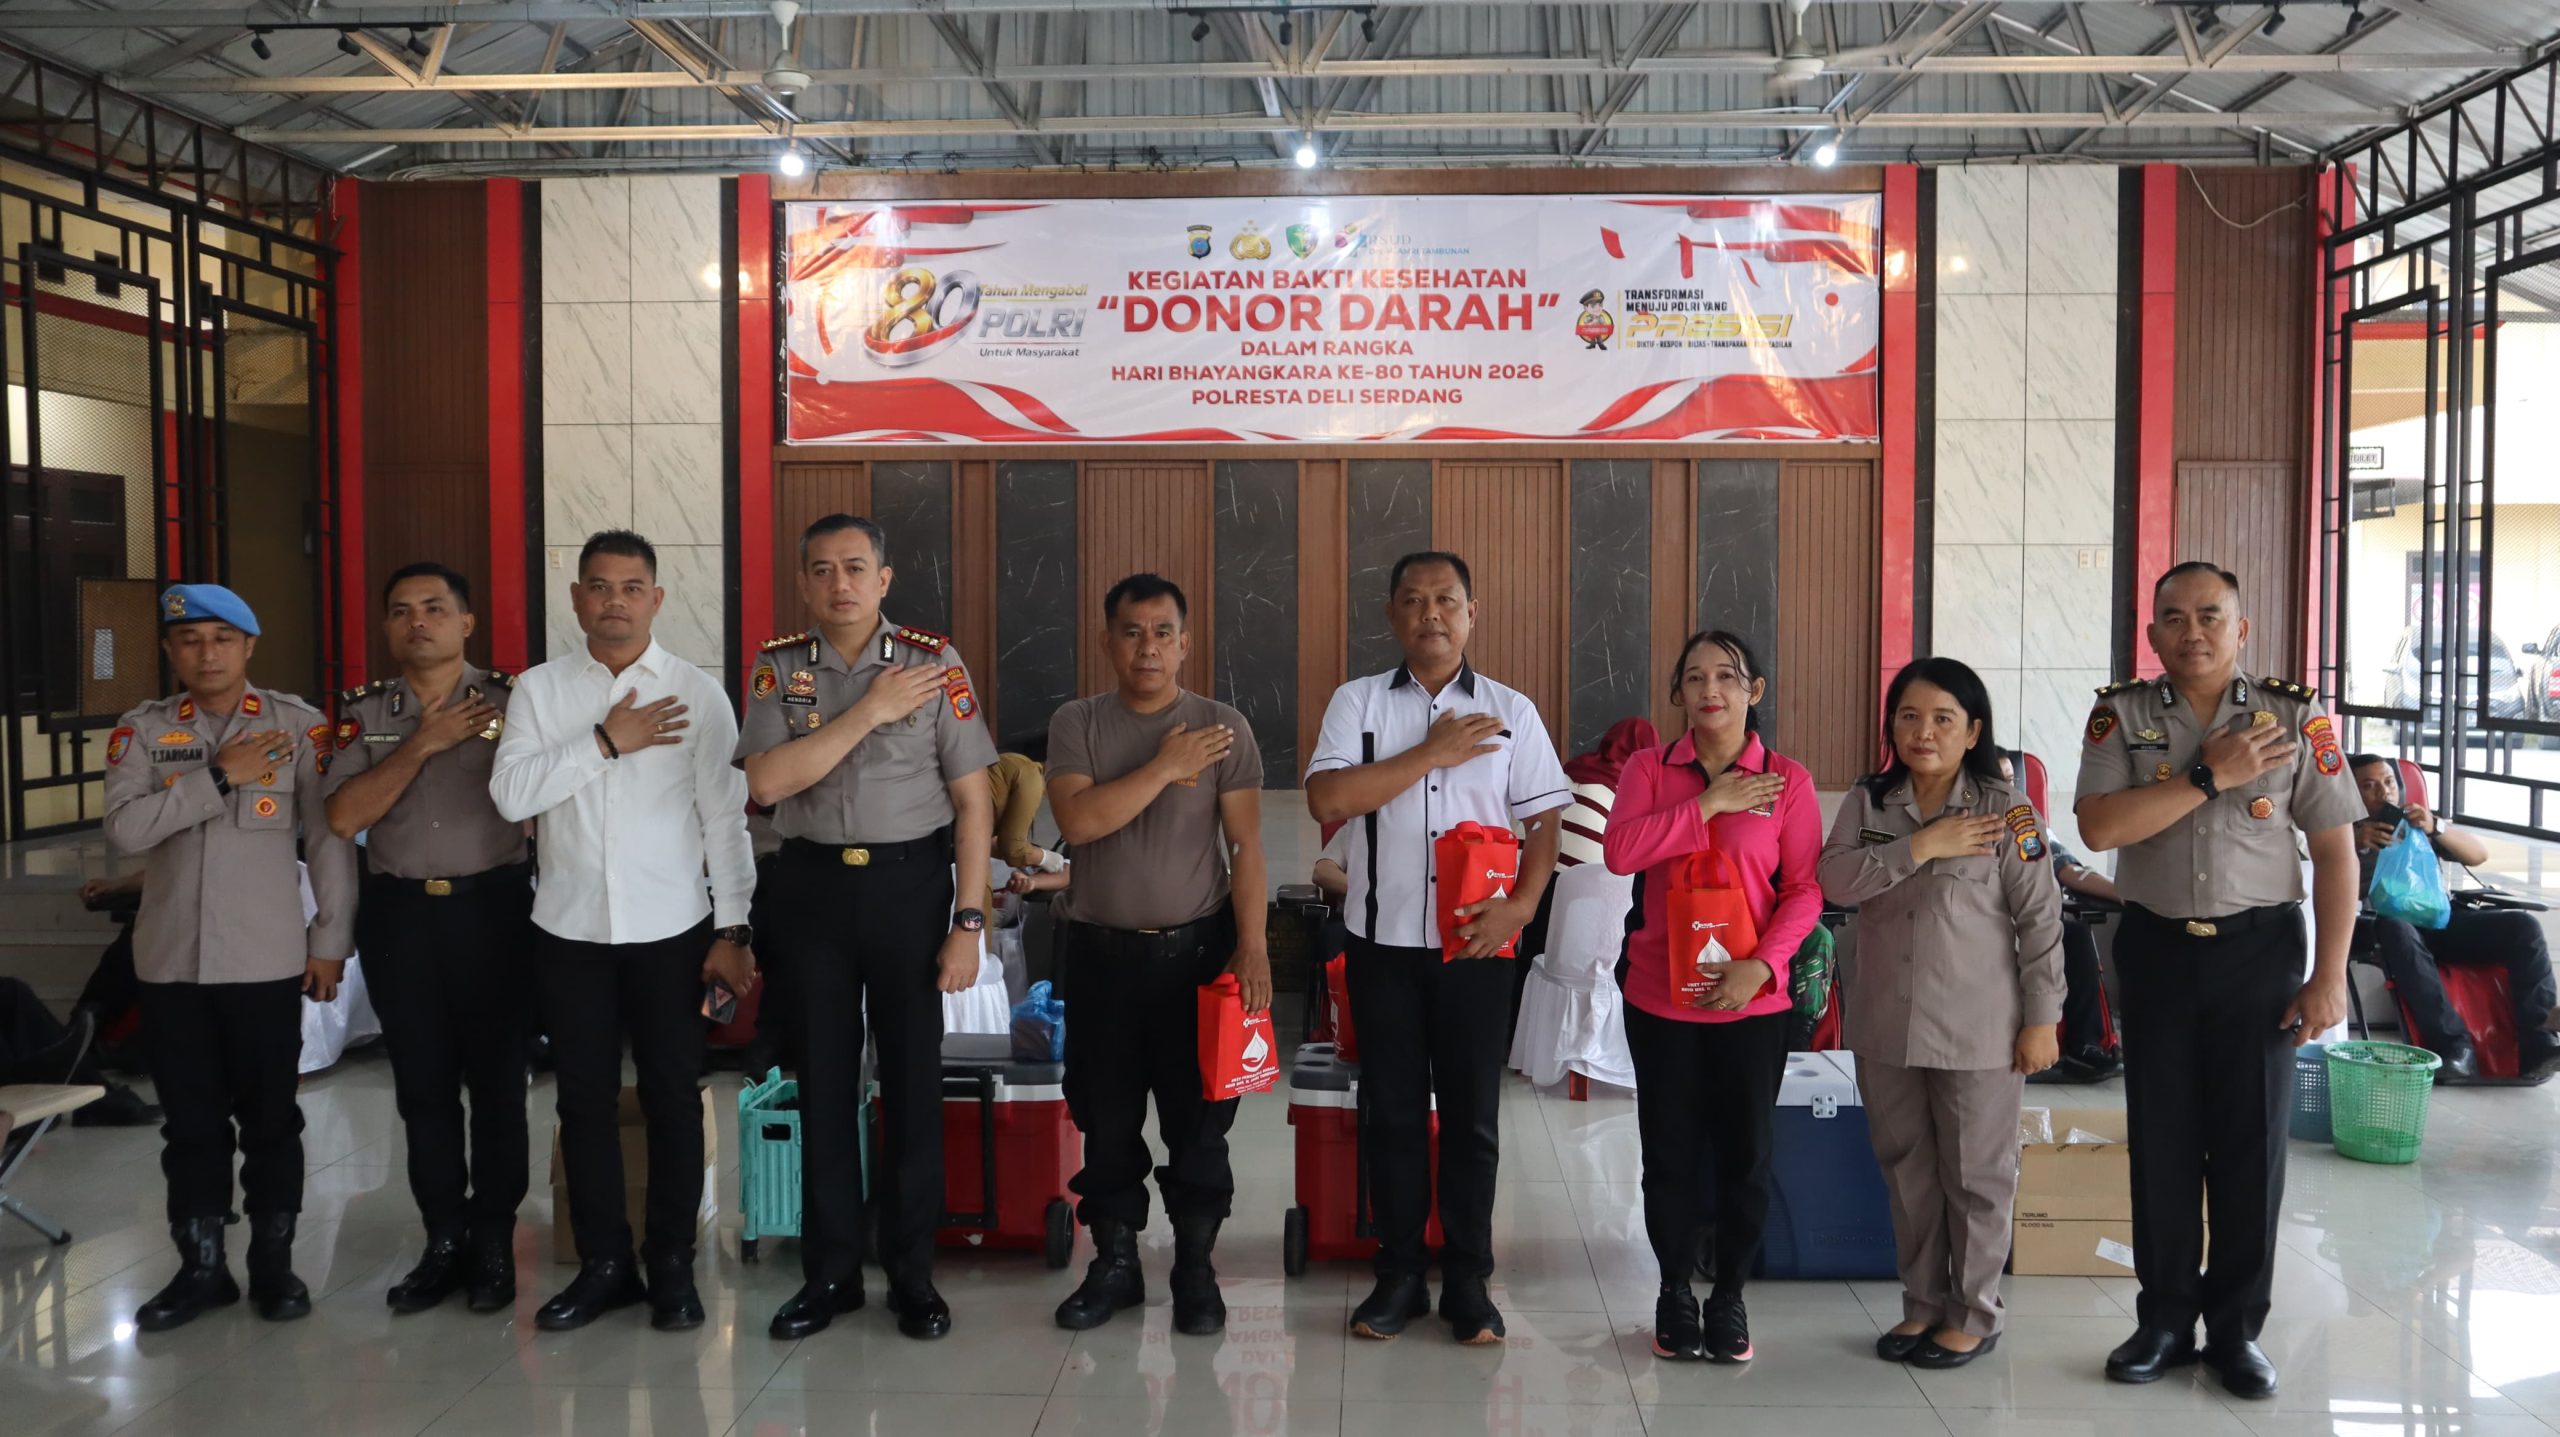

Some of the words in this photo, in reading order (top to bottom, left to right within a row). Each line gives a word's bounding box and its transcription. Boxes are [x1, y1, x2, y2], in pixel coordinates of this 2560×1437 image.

[1128, 270, 1265, 291] KEGIATAN
[1273, 269, 1354, 290] BAKTI
[1362, 268, 1527, 289] KESEHATAN
[979, 283, 1017, 297] Tahun
[1021, 283, 1088, 299] Mengabdi
[1625, 289, 1704, 300] TRANSFORMASI
[1097, 294, 1323, 334] "DONOR
[1340, 292, 1560, 332] DARAH"
[1626, 302, 1668, 312] MENUJU
[1671, 302, 1700, 311] POLRI
[1703, 301, 1728, 311] YANG
[865, 268, 980, 367] 80
[979, 307, 1087, 338] POLRI
[979, 348, 1012, 357] Untuk
[1015, 347, 1080, 358] Masyarakat
[1241, 341, 1317, 356] DALAM
[1323, 340, 1413, 356] RANGKA
[1111, 365, 1164, 381] HARI
[1169, 364, 1333, 381] BHAYANGKARA
[1337, 364, 1403, 381] KE-80
[1409, 364, 1483, 380] TAHUN
[1487, 363, 1544, 381] 2026
[1191, 388, 1302, 405] POLRESTA
[1307, 389, 1355, 405] DELI
[1360, 387, 1465, 405] SERDANG
[151, 747, 203, 763] T.TARIGAN
